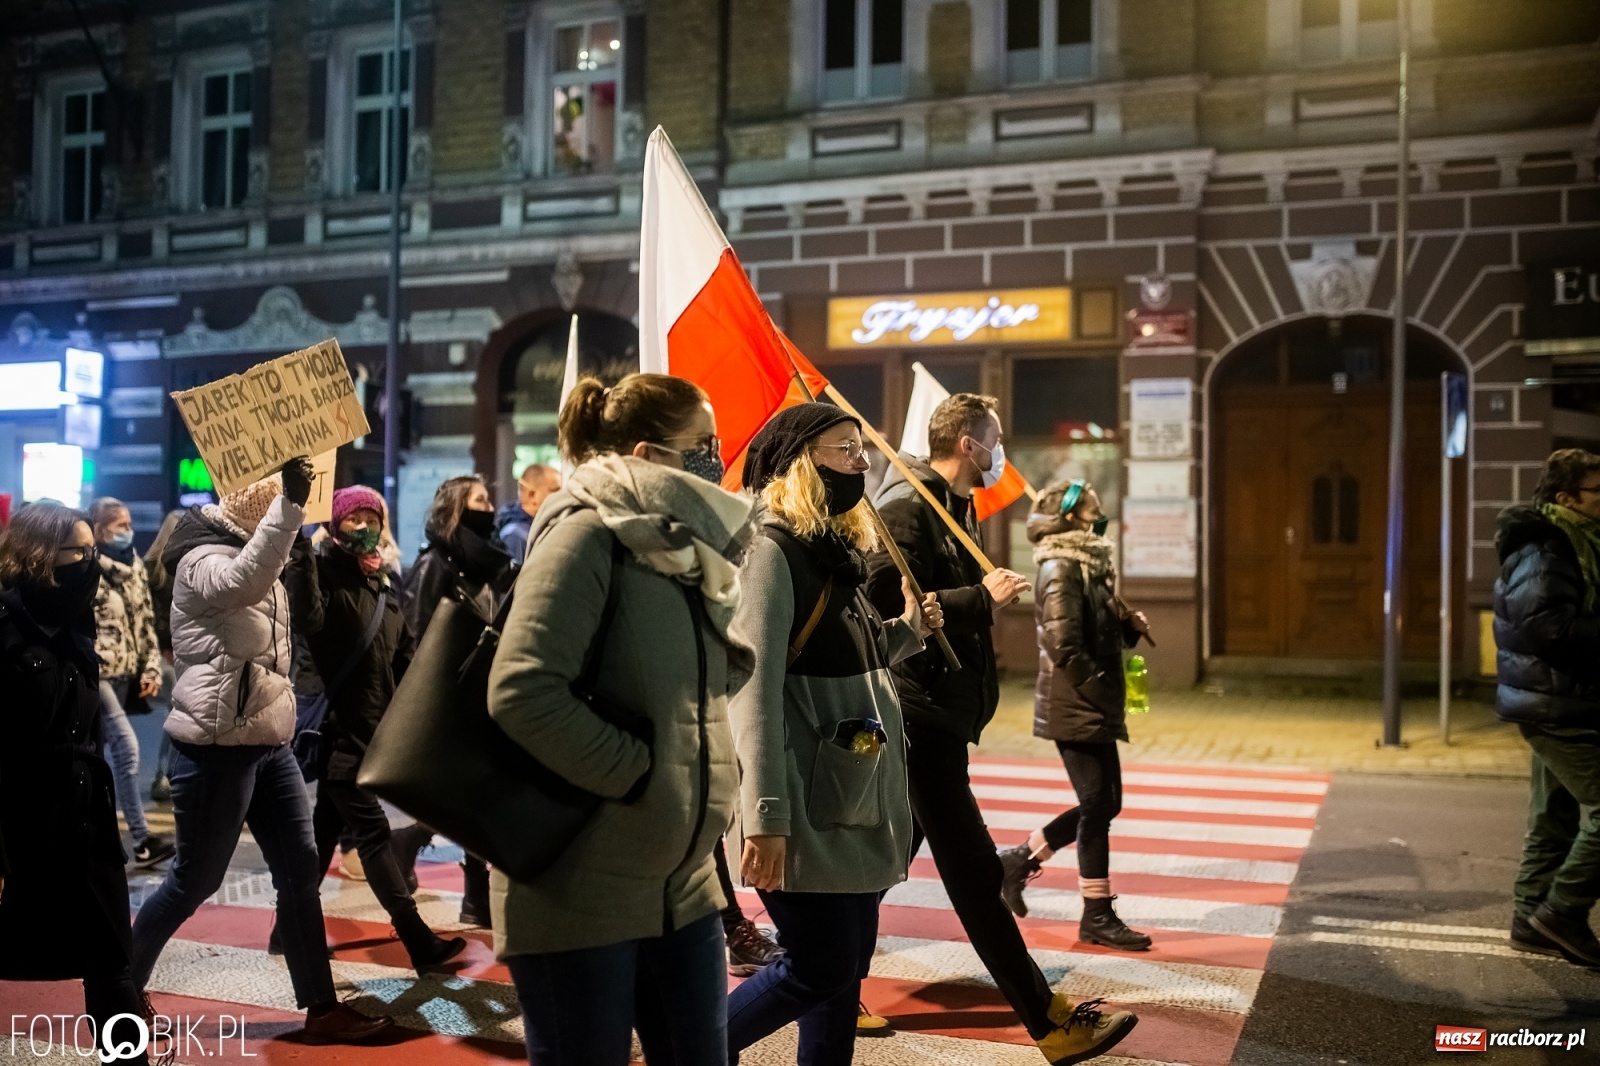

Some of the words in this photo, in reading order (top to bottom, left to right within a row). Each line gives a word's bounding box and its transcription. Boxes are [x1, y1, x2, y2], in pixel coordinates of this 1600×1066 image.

[851, 296, 1040, 343] Fryzjer
[250, 369, 282, 398] TO
[284, 346, 346, 386] TWOJA
[249, 394, 313, 431] TWOJA
[311, 376, 355, 408] BARDZO
[206, 435, 285, 486] WIELKA
[286, 416, 333, 450] WINA
